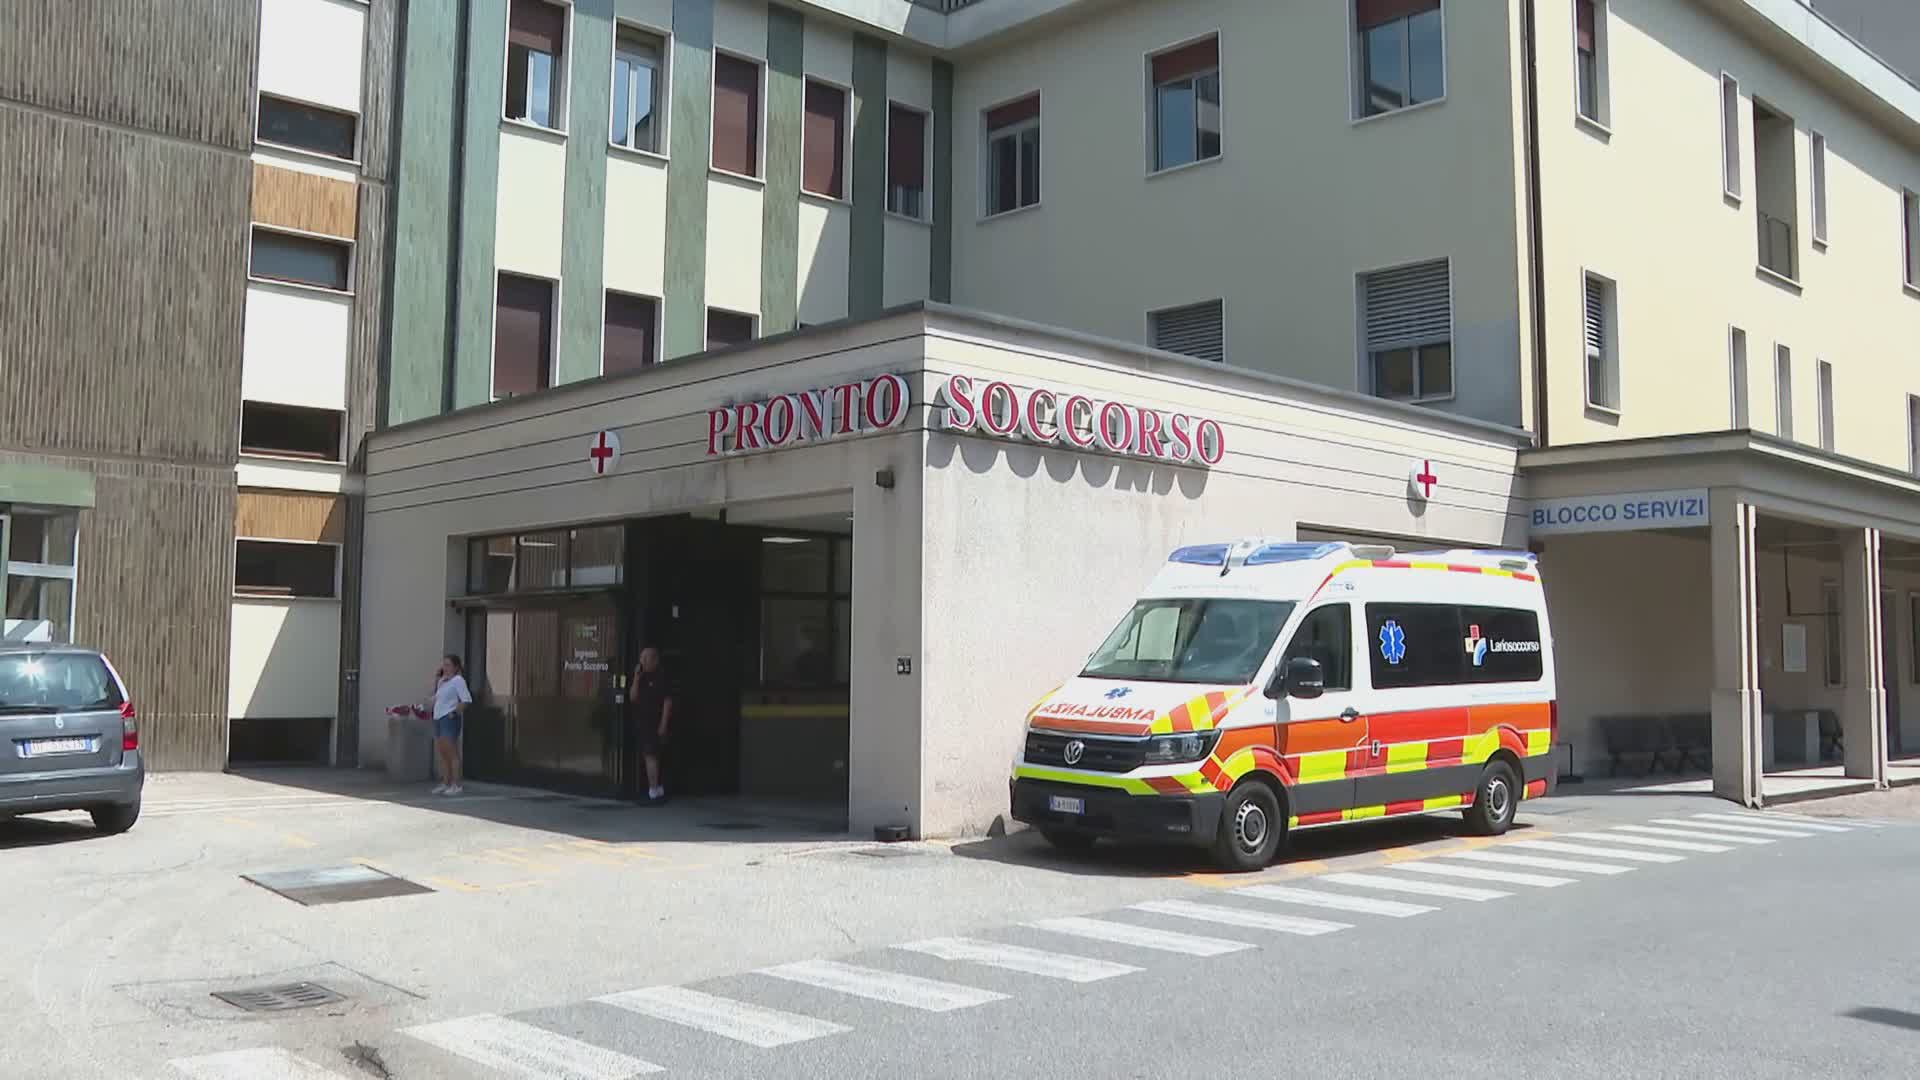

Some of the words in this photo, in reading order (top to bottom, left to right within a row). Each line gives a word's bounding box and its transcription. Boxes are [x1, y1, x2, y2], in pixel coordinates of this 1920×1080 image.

[706, 373, 910, 455] PRONTO
[940, 374, 1225, 465] SOCCORSO
[1532, 504, 1617, 526] BLOCCO
[1623, 498, 1704, 520] SERVIZI
[1490, 639, 1540, 652] Lariosoccorso
[583, 661, 609, 671] Soccorso
